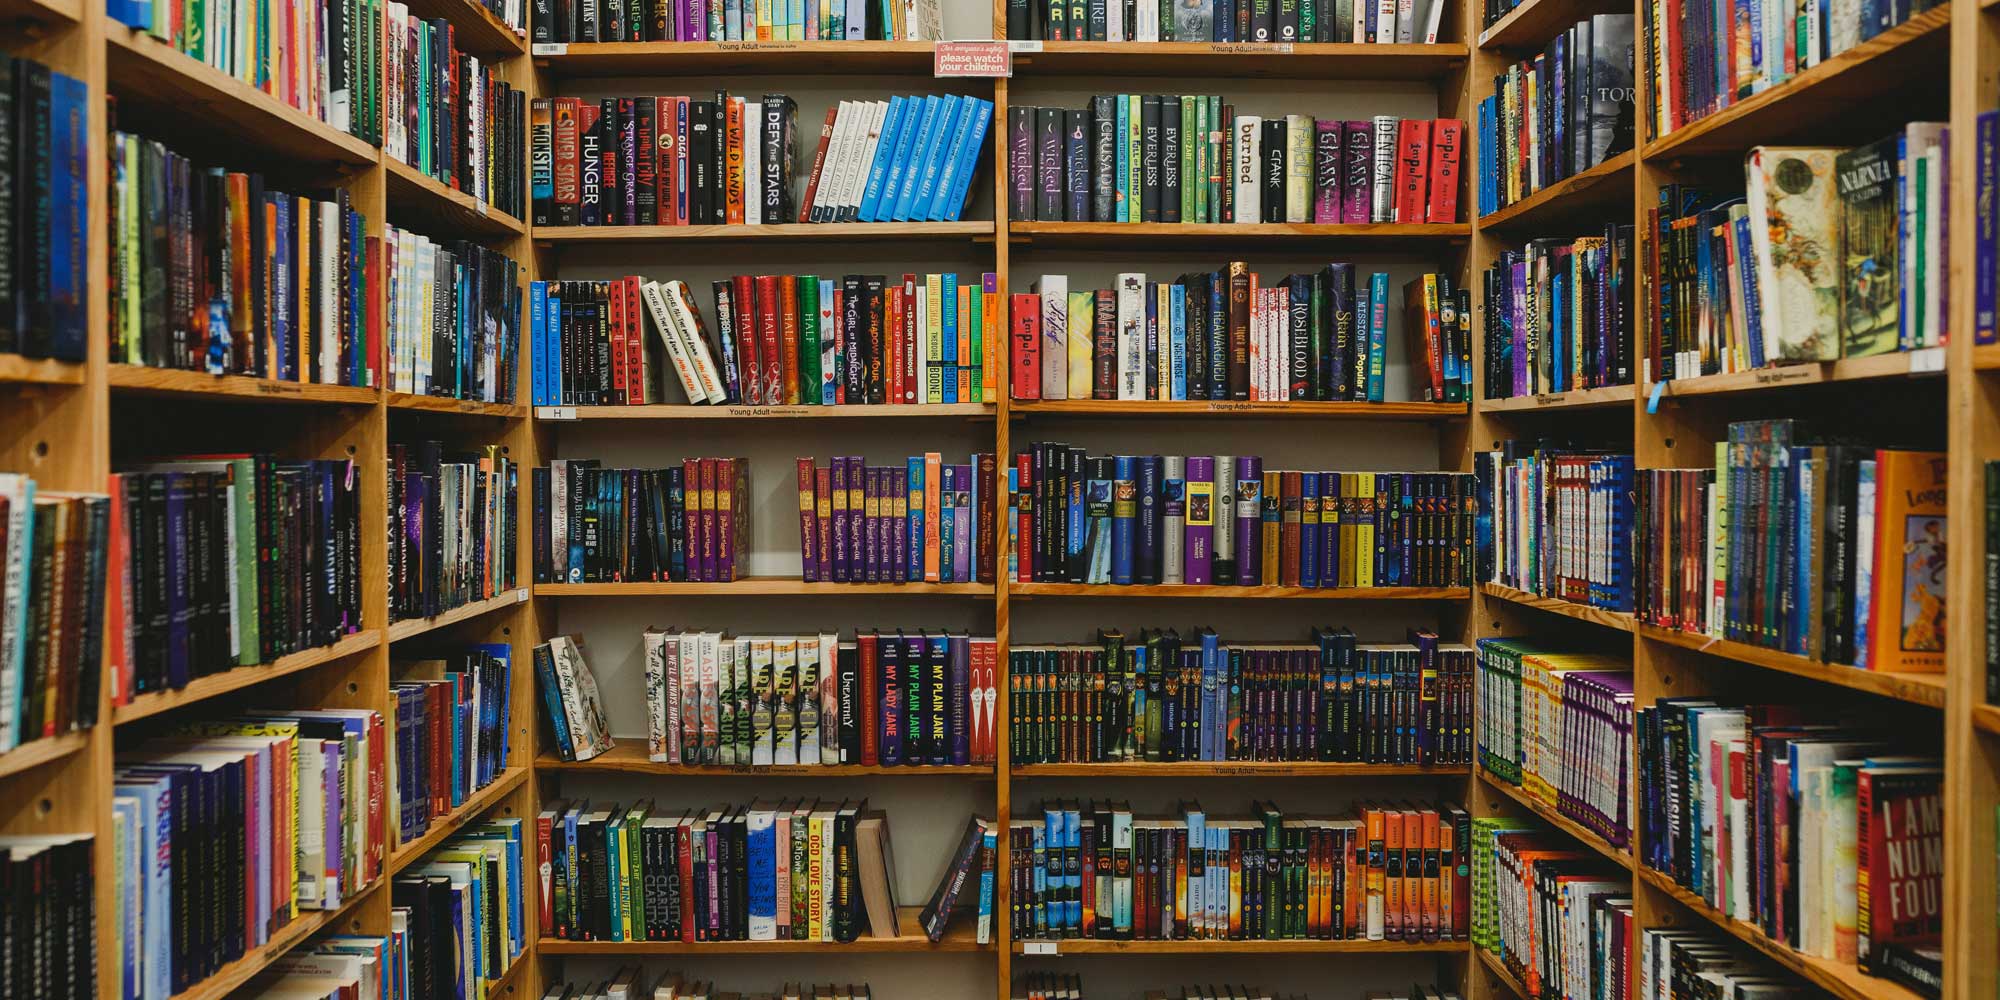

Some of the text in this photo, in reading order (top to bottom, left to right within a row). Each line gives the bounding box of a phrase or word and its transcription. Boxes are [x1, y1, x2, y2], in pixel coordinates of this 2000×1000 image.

[939, 62, 1005, 73] your children.
[941, 53, 1003, 63] please watch
[678, 135, 686, 159] OLGA
[729, 128, 739, 161] WILD
[767, 113, 780, 149] DEFY
[533, 124, 550, 186] MONSTER
[557, 119, 575, 201] SILVER STARS
[584, 136, 599, 205] HUNGER
[603, 152, 616, 189] REFUGEE
[621, 120, 635, 206] STRANGE GRACE
[1100, 121, 1113, 195] CRUSADE
[1144, 127, 1157, 187] EVERLESS
[1163, 127, 1177, 188] EVERLESS
[1241, 123, 1254, 185] burned
[1377, 120, 1395, 187] IDENTICAL
[728, 166, 740, 206] LANDS
[767, 163, 780, 206] STARS
[741, 313, 752, 343] HALF
[764, 313, 775, 343] HALF
[784, 313, 794, 343] HALF
[805, 313, 815, 343] HALF
[1294, 303, 1308, 379] ROSEBLOOD
[1335, 310, 1352, 349] Stain
[1357, 301, 1366, 341] MISSION
[906, 343, 914, 377] TREEHOUSE
[1174, 342, 1183, 379] NIGHTRISE
[1213, 311, 1225, 381] REAWAKENED
[871, 357, 881, 384] HOUR
[929, 367, 942, 395] BOONE
[945, 367, 956, 395] BOONE
[960, 371, 968, 389] BOONE
[973, 370, 981, 389] BOONE
[729, 408, 750, 416] Young
[668, 654, 679, 724] WE'LL ALWAYS HAVE
[841, 671, 854, 728] UNEARTHLY
[885, 665, 896, 737] MY LADY JANE
[909, 665, 920, 740] MY PLAIN JANE
[932, 665, 944, 740] MY PLAIN JANE
[1882, 800, 1893, 838] I
[810, 835, 820, 923] OCD LOVE STORY
[644, 874, 657, 925] CLARITY
[656, 875, 668, 925] CLARITY
[668, 874, 680, 925] CLARITY
[1889, 881, 1938, 919] FOU
